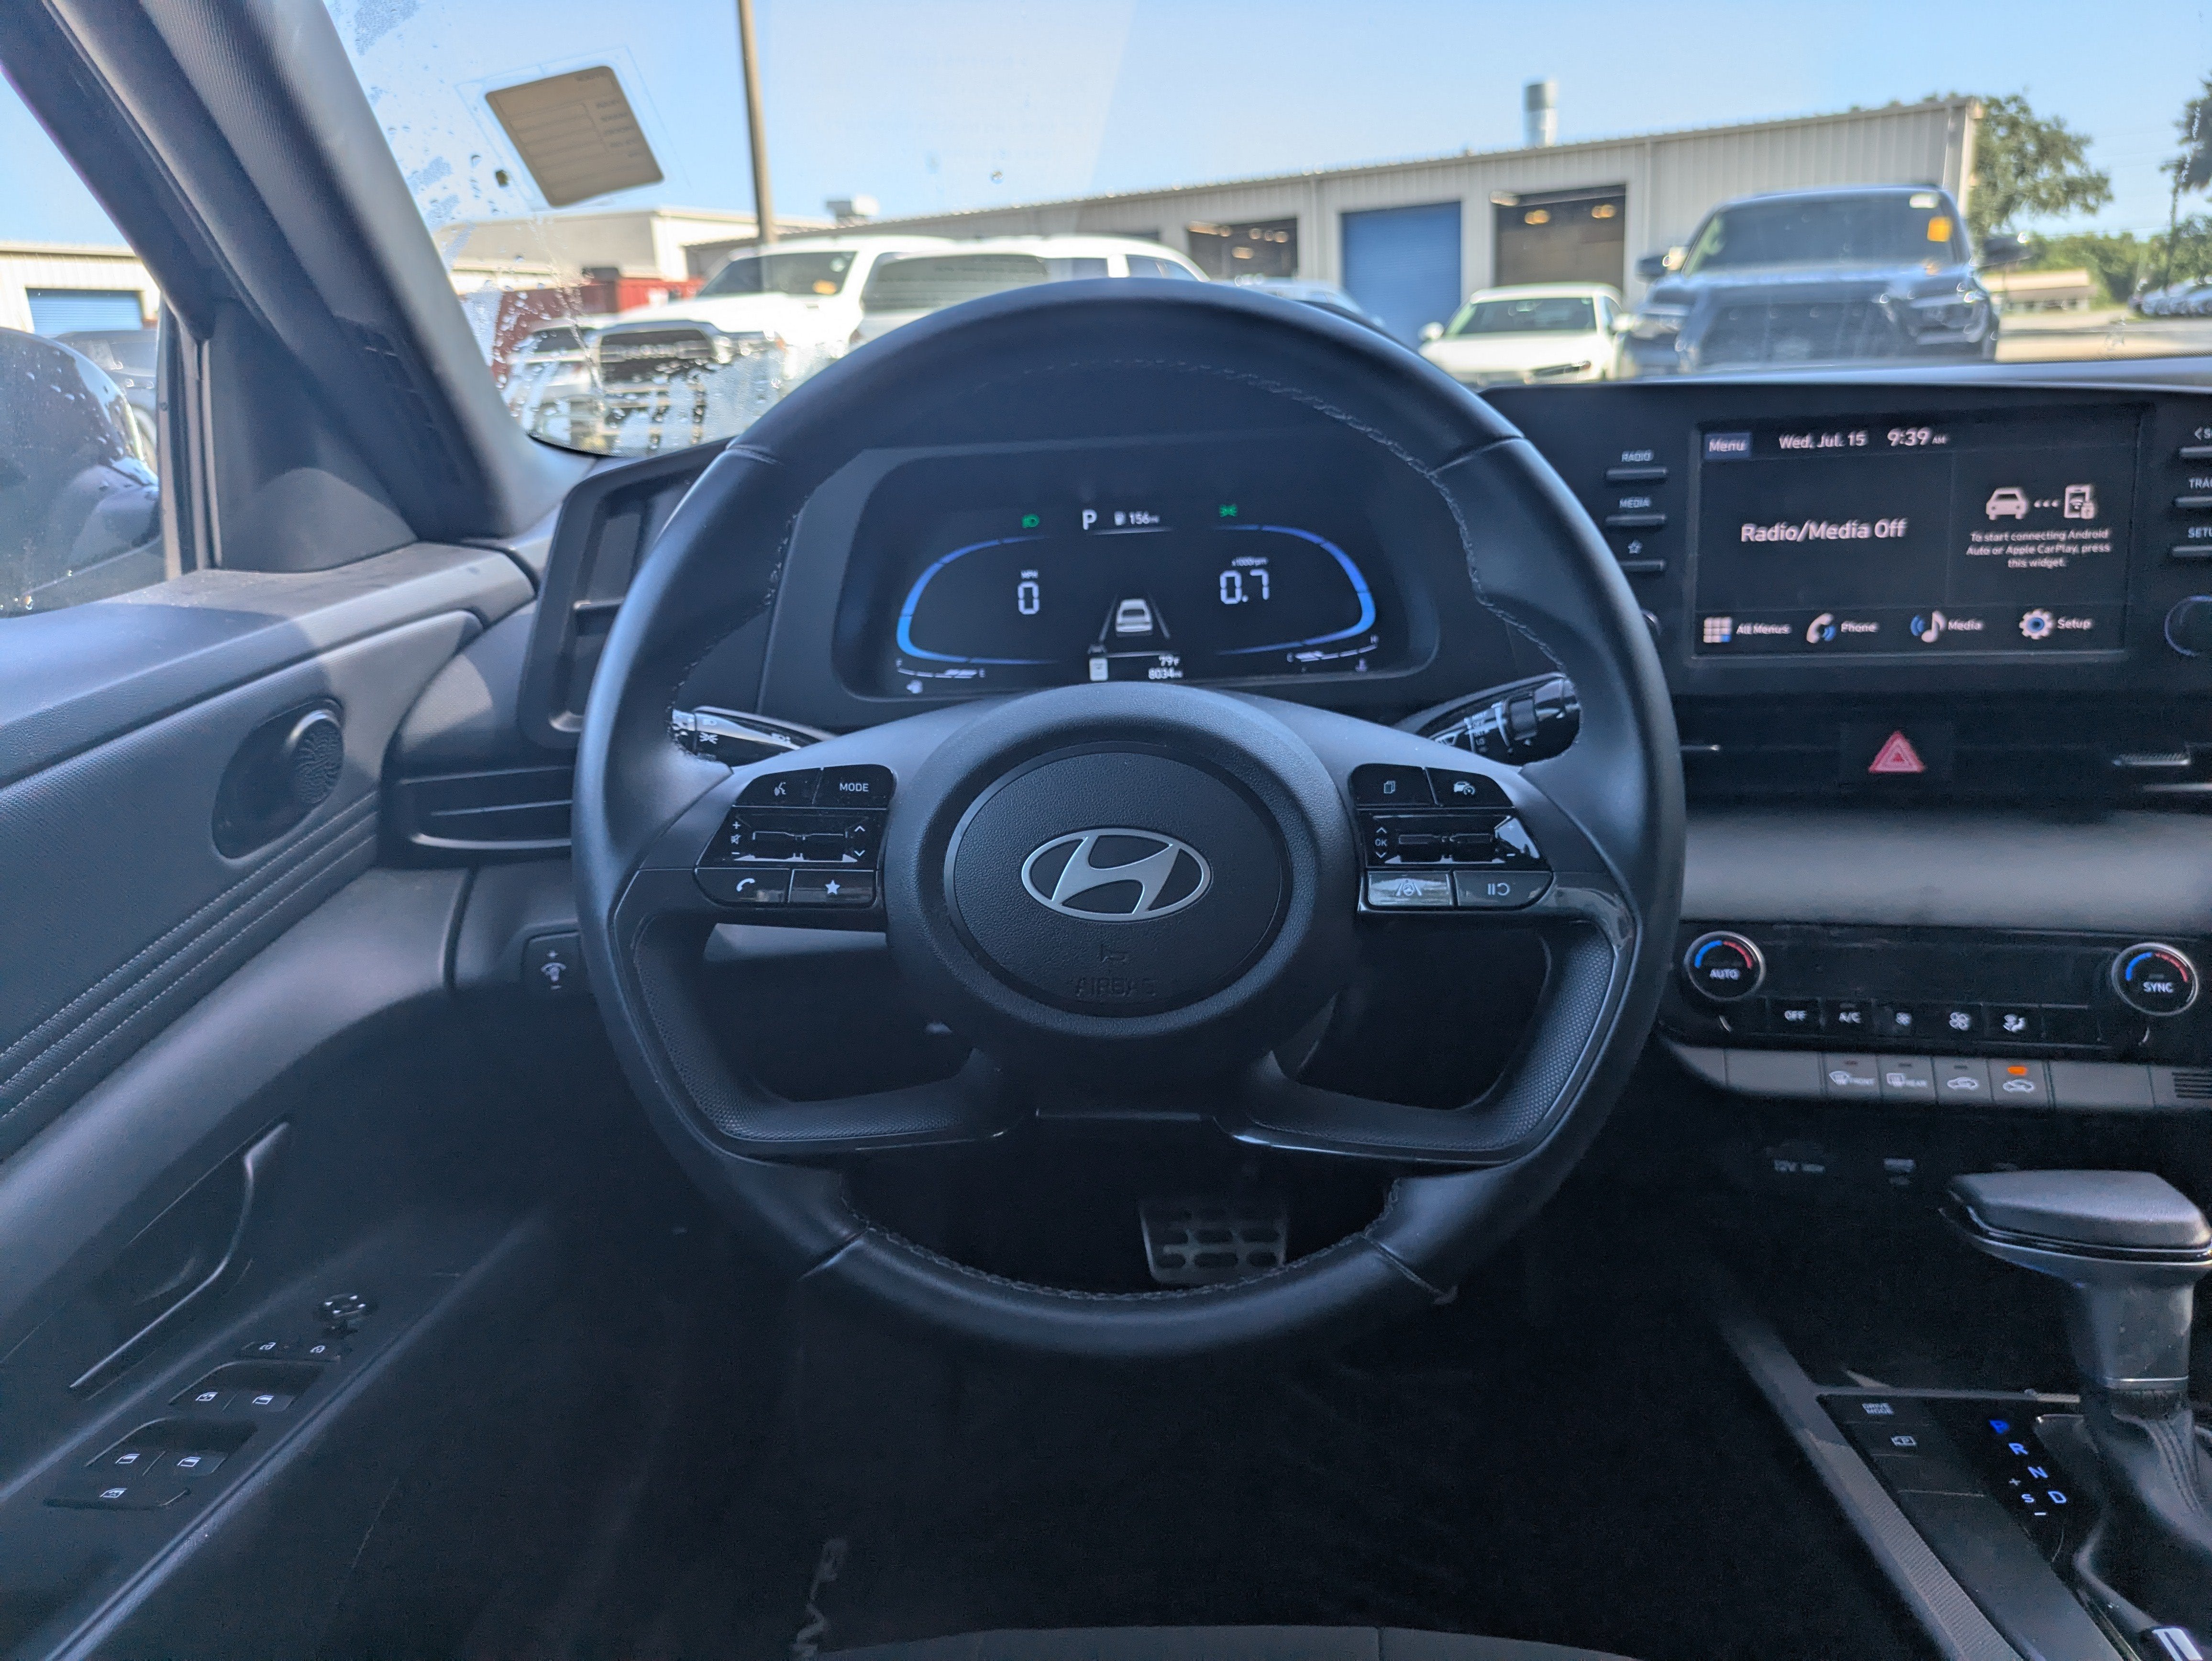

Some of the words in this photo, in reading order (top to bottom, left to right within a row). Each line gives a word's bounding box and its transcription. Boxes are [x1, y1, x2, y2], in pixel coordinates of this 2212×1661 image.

[1847, 430, 1868, 446] 15
[1887, 427, 1932, 446] 9:39
[1932, 434, 1949, 444] AM
[1709, 438, 1746, 452] Menu
[1621, 449, 1654, 462] RADIO
[1619, 497, 1651, 508] MEDIA
[1082, 509, 1097, 530] P
[1741, 519, 1872, 542] Radio/Media
[1874, 518, 1908, 538] Off
[1971, 532, 1983, 542] To
[1984, 531, 2009, 542] start
[2011, 529, 2066, 542] connecting
[2068, 528, 2110, 540] Android
[1966, 544, 1991, 555] Auto
[1992, 546, 2004, 555] or
[2006, 543, 2036, 555] Apple
[2081, 544, 2111, 554] press
[2008, 557, 2027, 568] this
[1220, 569, 1270, 604] 0.7
[1018, 581, 1040, 615] 0
[1736, 623, 1752, 634] All
[1753, 623, 1792, 634] Menus
[1841, 621, 1879, 632] Phone
[1948, 620, 1983, 631] Media
[2057, 618, 2093, 630] Setup
[840, 783, 869, 792] MODE
[1375, 838, 1387, 846] OK
[1710, 969, 1740, 980] AUTO
[2144, 982, 2173, 993] SYNC
[1839, 1012, 1861, 1023] A/C
[1989, 1419, 2008, 1434] P
[2009, 1443, 2028, 1454] R
[2027, 1466, 2048, 1478] N
[2021, 1494, 2035, 1503] S
[2047, 1491, 2067, 1503] D
